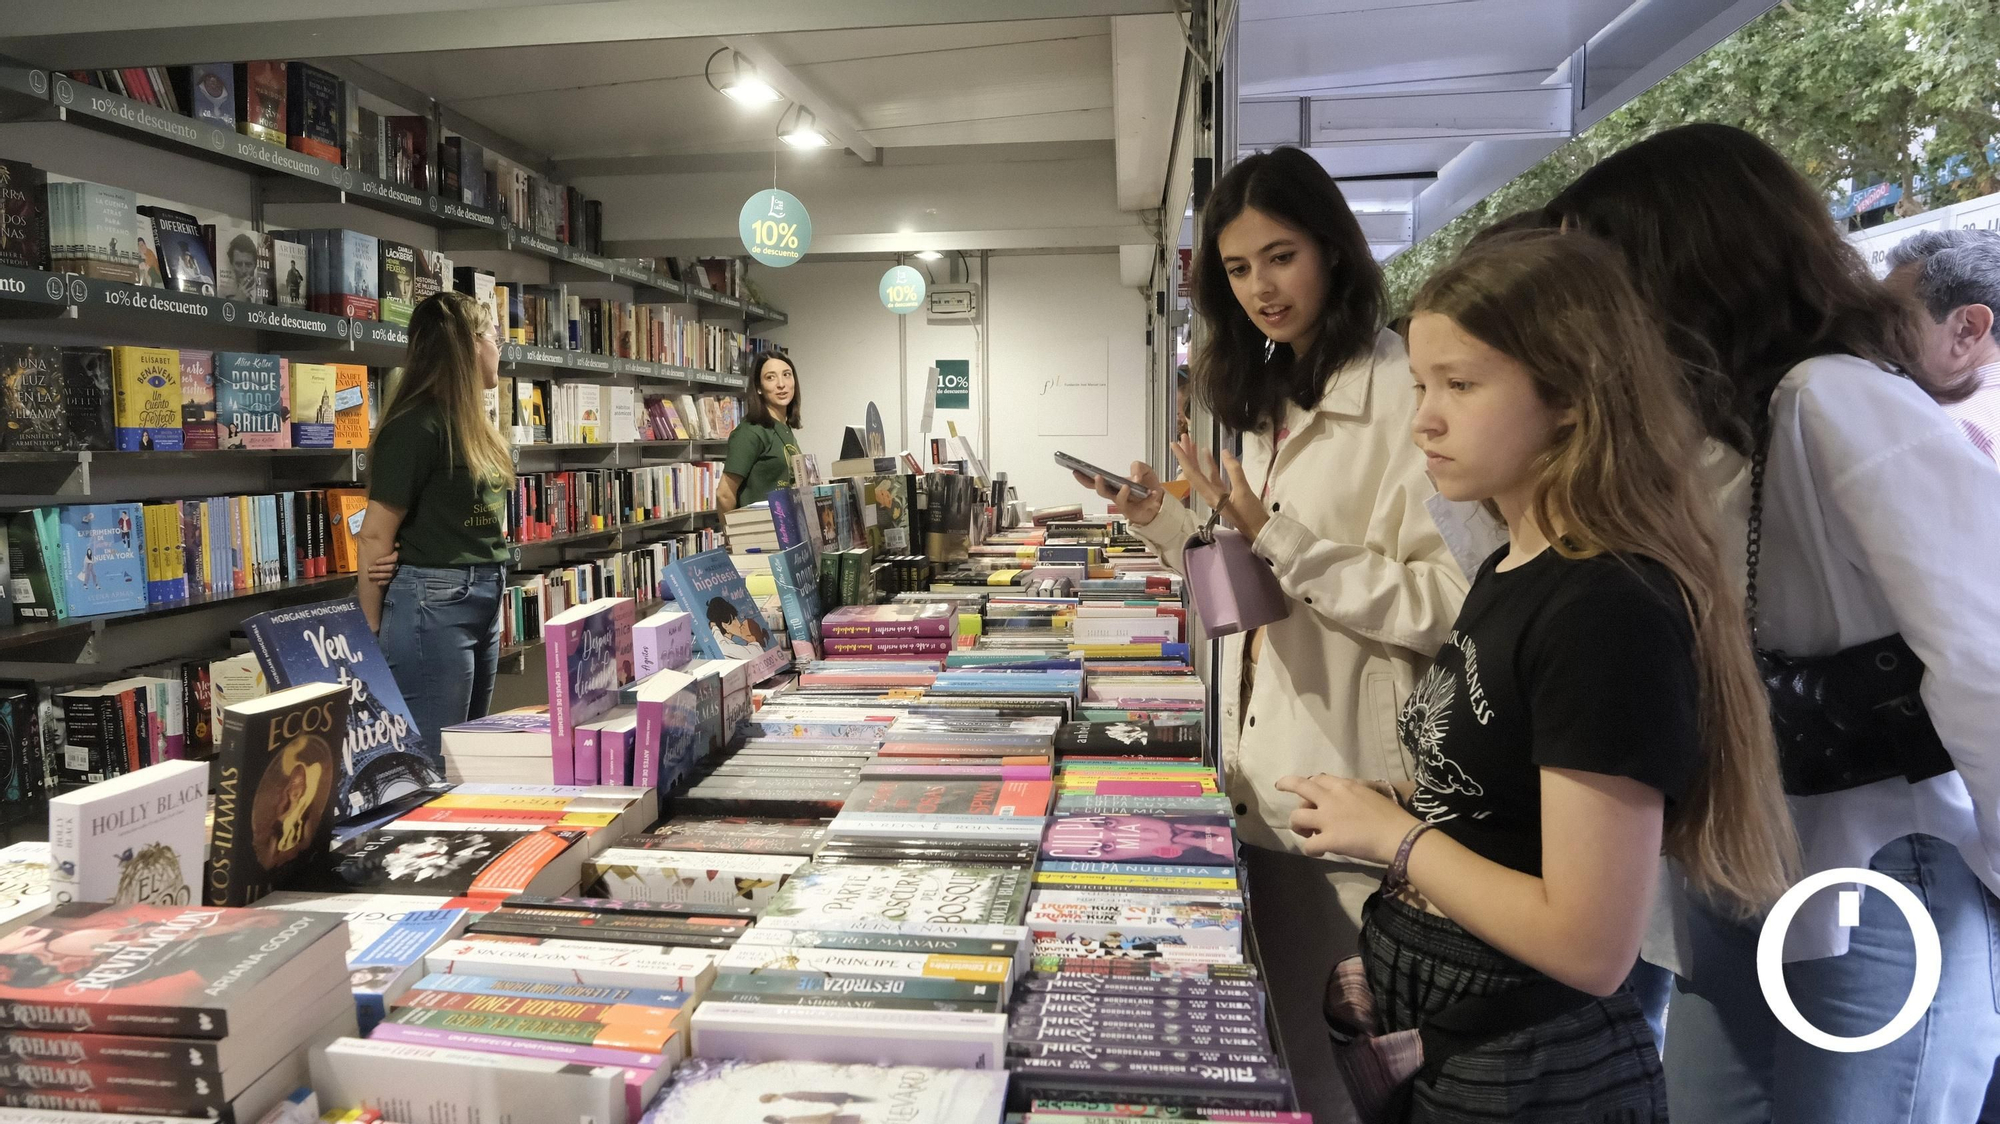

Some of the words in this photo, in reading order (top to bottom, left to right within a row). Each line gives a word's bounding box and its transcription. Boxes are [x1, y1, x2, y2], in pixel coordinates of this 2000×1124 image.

[92, 98, 118, 116] 10%
[120, 104, 134, 120] de
[138, 109, 197, 140] descuento
[259, 118, 278, 130] HUGO
[238, 144, 258, 159] 10%
[259, 148, 270, 162] de
[272, 151, 320, 176] descuento
[362, 182, 378, 194] 10%
[378, 184, 388, 196] de
[388, 186, 422, 206] descuento
[1856, 186, 1887, 213] VENDIDO
[104, 199, 128, 210] CUENTA
[444, 204, 456, 215] 10%
[458, 206, 465, 218] de
[465, 208, 494, 226] descuento
[160, 218, 200, 237] DIFERENTE
[752, 220, 798, 248] 10%
[398, 246, 413, 254] CAMILLA
[752, 246, 761, 254] de
[762, 247, 799, 258] descuento
[386, 264, 407, 274] FEXEUS
[422, 284, 440, 292] MUJERES
[886, 285, 917, 302] 10%
[105, 290, 131, 307] 10%
[133, 292, 148, 310] de
[150, 294, 208, 317] descuento
[248, 311, 268, 325] 10%
[269, 312, 280, 326] de
[282, 314, 327, 332] descuento
[372, 329, 387, 340] 10%
[387, 330, 396, 342] de
[18, 358, 47, 370] UNA
[140, 355, 171, 365] ELÍSABET
[187, 361, 204, 375] arte
[234, 357, 251, 366] Alice
[253, 358, 273, 368] Kellen
[22, 375, 46, 386] LUZ
[136, 366, 176, 386] BENAVENT
[232, 370, 276, 391] DONDE
[937, 375, 968, 388] 10%
[18, 391, 34, 402] EN
[37, 392, 52, 403] LA
[144, 398, 170, 410] Cuento
[152, 390, 162, 401] Un
[238, 393, 272, 410] TODO
[16, 408, 57, 420] LLAMA
[139, 410, 177, 428] Perfecto
[233, 413, 279, 432] BRILLA
[464, 518, 473, 527] el
[476, 516, 498, 526] libro
[78, 528, 120, 538] EXPERIMENTO
[93, 553, 115, 562] NUEVA
[116, 552, 134, 560] YORK
[692, 570, 738, 592] hipótesis
[731, 590, 745, 600] amor
[270, 610, 310, 624] MORGANE
[311, 602, 356, 617] MONCOMBLE
[252, 624, 269, 655] MONCOMBLE
[303, 625, 363, 668] Ven,
[582, 625, 613, 661] Después
[266, 655, 281, 685] MORGANE
[575, 651, 617, 698] diciembre
[338, 667, 367, 704] te
[1461, 634, 1495, 725] UNIQUENESS
[268, 701, 334, 751] ECOS
[92, 802, 150, 836] HOLLY
[157, 782, 204, 814] BLACK
[56, 818, 64, 848] HOLLY
[65, 817, 73, 848] BLACK
[1049, 817, 1106, 858] CULPA
[1114, 823, 1141, 850] MÍA
[1071, 861, 1119, 873] CULPA
[1126, 865, 1210, 875] NUESTRA
[139, 874, 160, 900] EL
[999, 873, 1019, 896] BLACK
[822, 874, 872, 914] PARTE
[882, 872, 922, 918] OSCURA
[926, 871, 981, 923] BOSQUE
[989, 896, 1008, 925] HOLLY
[262, 915, 314, 952] GODOY
[850, 922, 901, 932] REINA
[920, 926, 969, 934] NADA
[74, 909, 212, 992] REVELACIÓN
[843, 936, 872, 946] REY
[875, 938, 958, 949] MALVADO
[474, 948, 500, 959] SIN
[500, 949, 570, 962] CORAZÓN
[824, 957, 898, 969] PRÍNCIPE
[205, 951, 264, 996] ARIANA
[1112, 975, 1160, 983] BORDERLAND
[562, 985, 611, 999] LEGADO
[796, 976, 905, 994] DESTRÓZAME
[1215, 989, 1250, 997] IVREA
[464, 994, 519, 1014] FINAL
[613, 990, 631, 1001] EL
[1104, 997, 1154, 1005] BORDERLAND
[1216, 1001, 1252, 1009] IVREA
[11, 1004, 94, 1031] REVELACIÓN
[519, 1000, 596, 1019] JUGADA
[1215, 1013, 1251, 1021] IVREA
[442, 1013, 489, 1030] JUEGO
[486, 1017, 508, 1032] EN
[508, 1018, 582, 1038] HERENCIA
[1103, 1021, 1155, 1029] BORDERLAND
[1220, 1025, 1257, 1034] IVREA
[7, 1030, 86, 1063] REVELACIÓN
[447, 1034, 468, 1042] UNA
[468, 1036, 512, 1047] PERFECTA
[512, 1041, 576, 1053] OPORTUNIDAD
[1219, 1038, 1257, 1046] IVREA
[1024, 1058, 1062, 1067] IVREA
[1106, 1048, 1161, 1057] BORDERLAND
[1228, 1054, 1267, 1063] IVREA
[1130, 1063, 1186, 1072] BORDERLAND
[1200, 1067, 1257, 1083] Alice
[16, 1064, 95, 1092] REVELACIÓN
